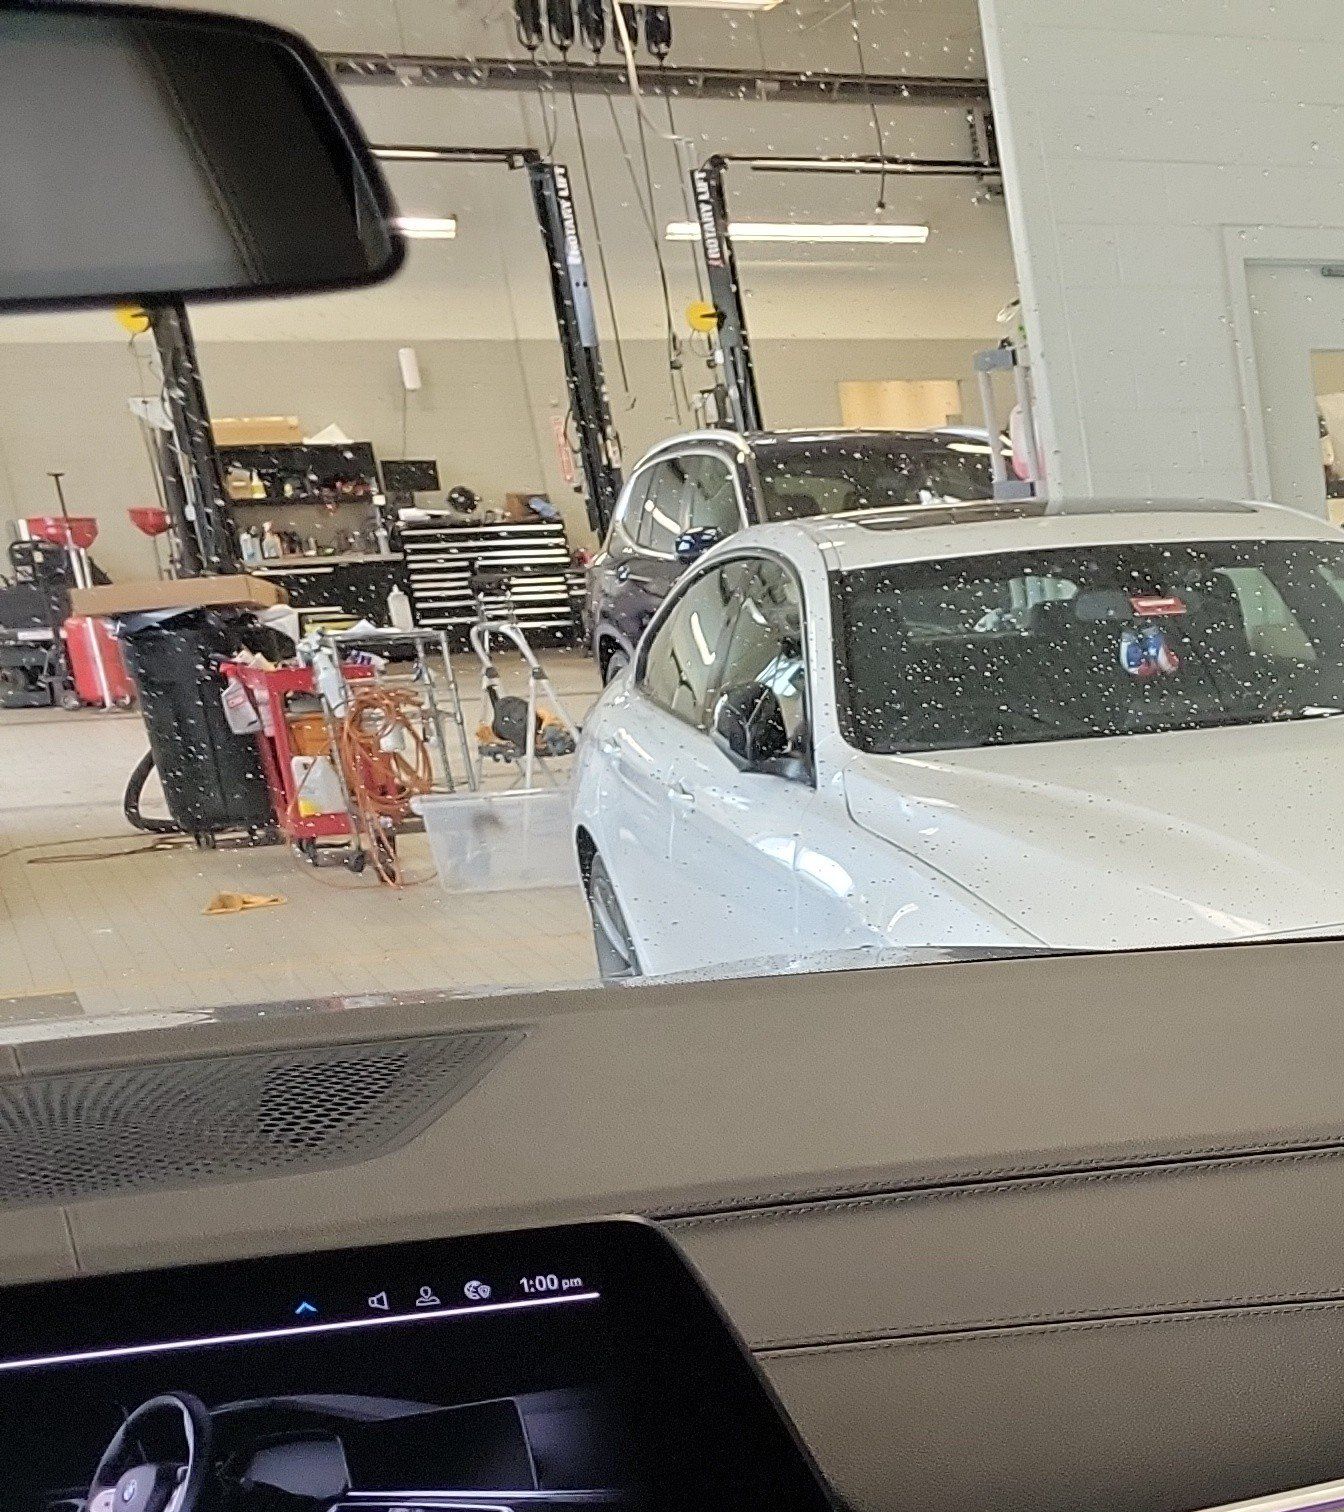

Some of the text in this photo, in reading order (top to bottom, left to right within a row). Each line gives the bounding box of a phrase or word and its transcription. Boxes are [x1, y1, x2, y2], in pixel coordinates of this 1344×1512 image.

[553, 165, 570, 198] LIFT
[694, 170, 721, 259] ROTARY LIFT
[519, 1274, 583, 1293] 1:00 pm
